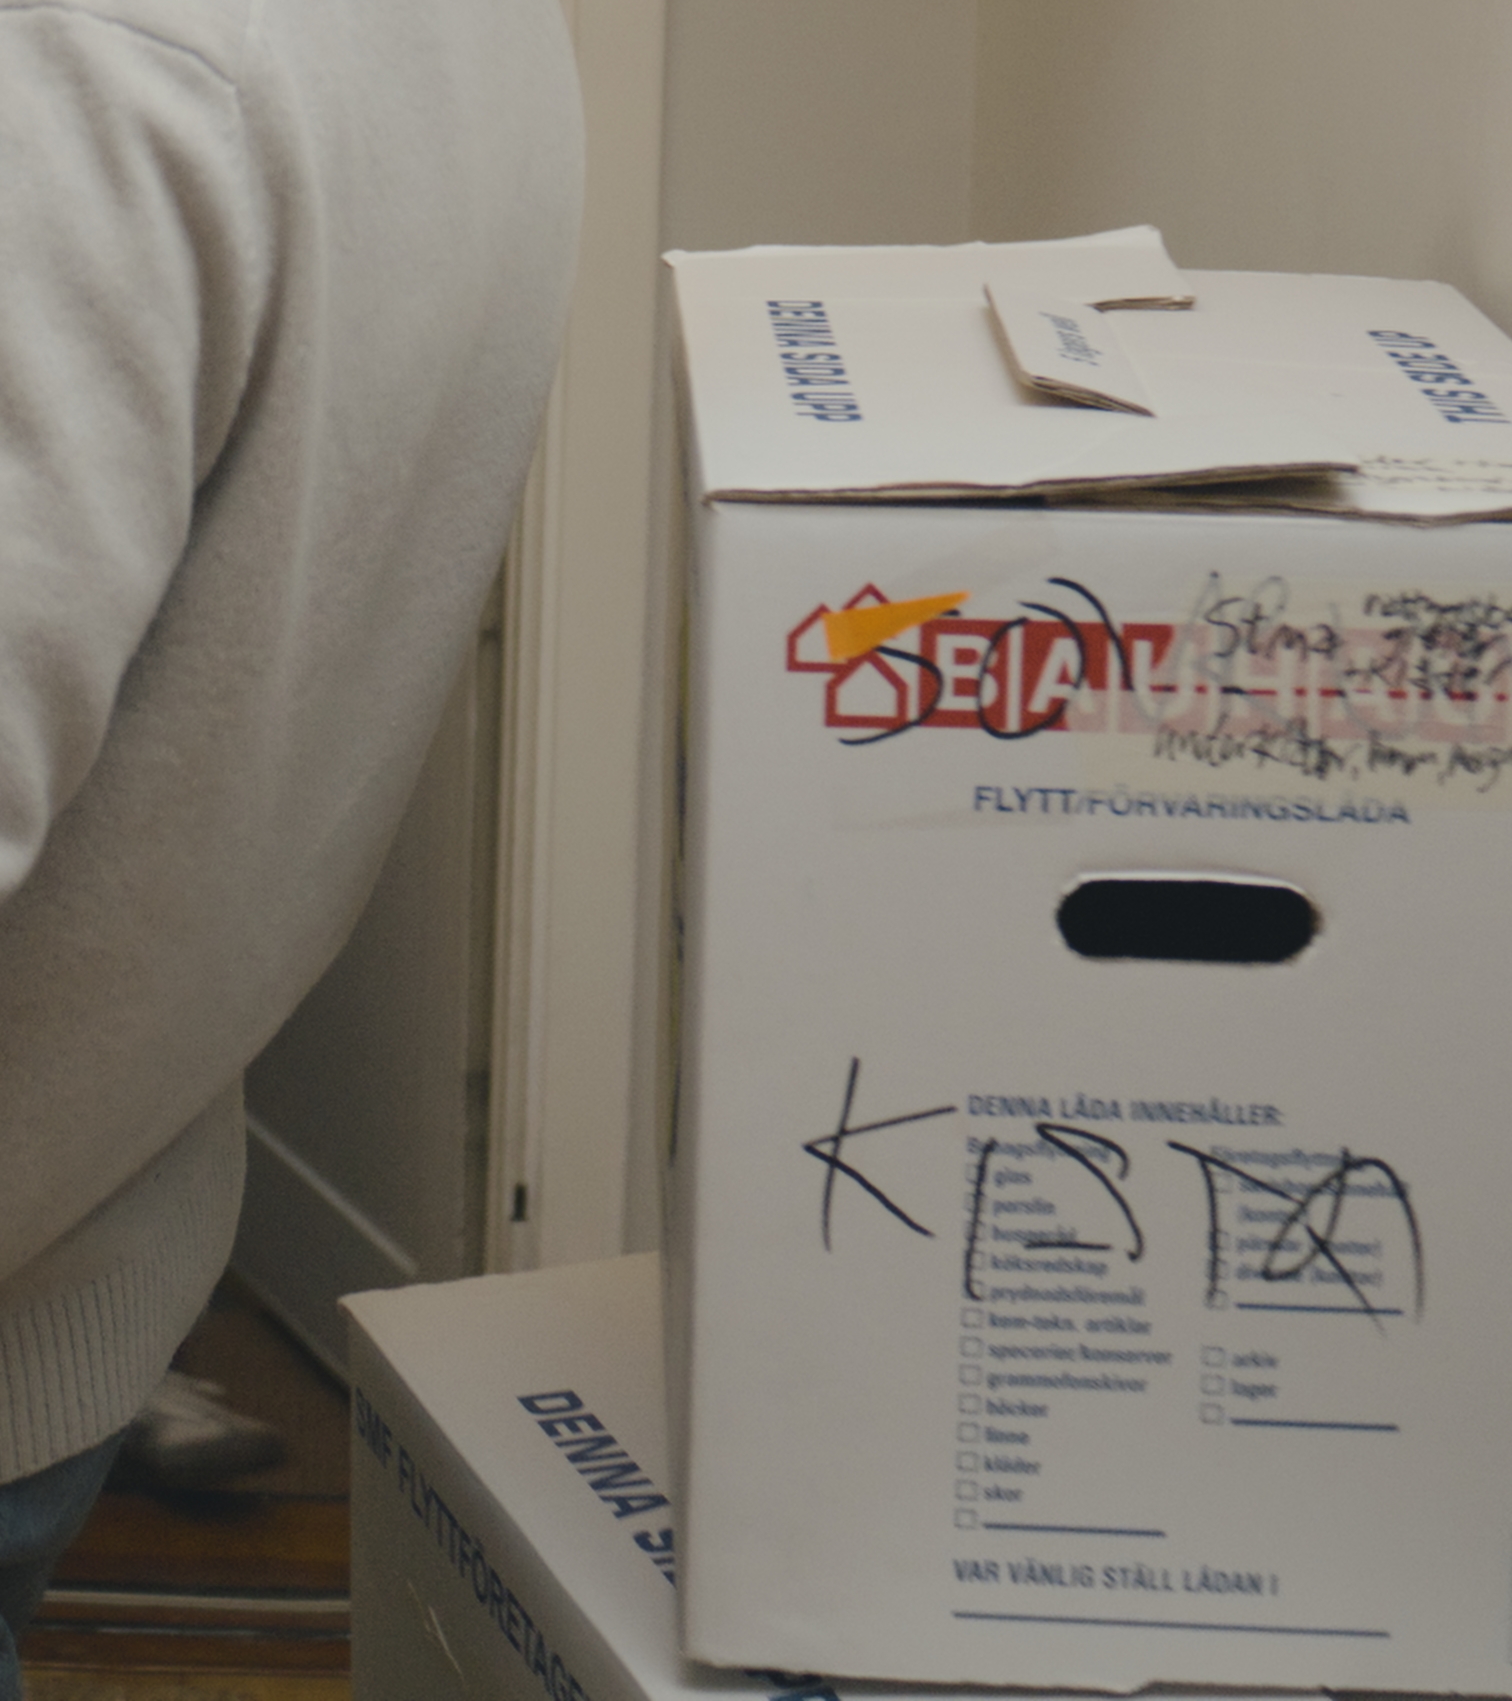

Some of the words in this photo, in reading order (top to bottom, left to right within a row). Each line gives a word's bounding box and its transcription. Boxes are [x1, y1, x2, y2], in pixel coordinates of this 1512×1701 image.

[765, 300, 838, 347] DENNA
[1366, 330, 1437, 350] UP
[779, 352, 850, 386] SIDA
[1385, 351, 1475, 386] SIDE
[789, 392, 864, 422] UPP
[973, 782, 1413, 826] FLYTT/FÖRVARINGSLÅDA
[967, 1094, 1051, 1119] DENNA
[1059, 1091, 1123, 1121] LÅDA
[994, 1167, 1033, 1187] glas
[354, 1386, 392, 1471] SMF
[517, 1389, 672, 1519] DENNA
[953, 1558, 1000, 1585] VAR
[1007, 1556, 1094, 1589] VÄNLIG
[1102, 1560, 1174, 1593] STÄLL
[1182, 1563, 1264, 1597] LÅDAN
[1269, 1572, 1281, 1597] I
